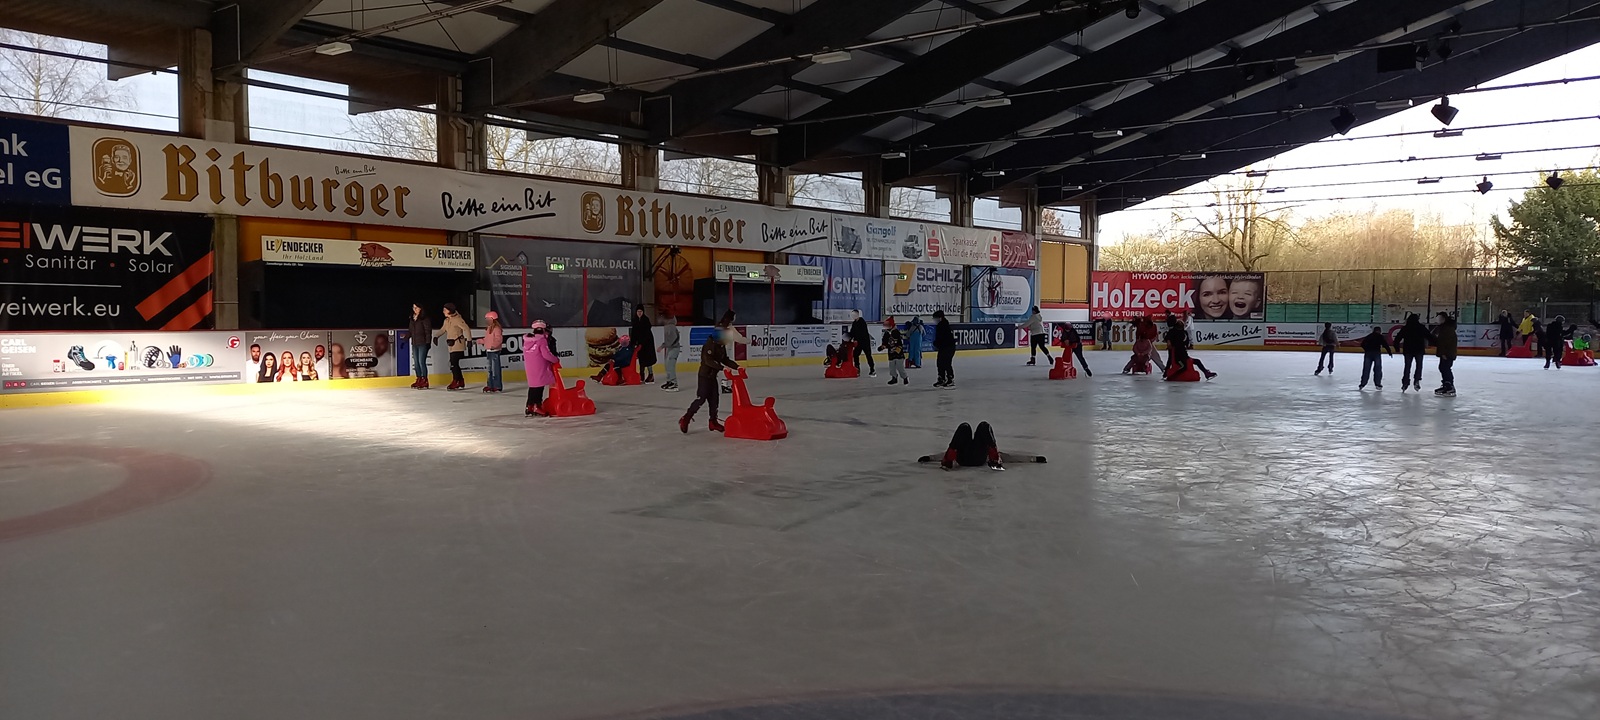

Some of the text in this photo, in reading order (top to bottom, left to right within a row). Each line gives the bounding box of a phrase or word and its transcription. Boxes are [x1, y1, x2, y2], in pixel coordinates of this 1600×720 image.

[25, 168, 62, 189] eG
[160, 142, 411, 219] Bitburger
[441, 187, 556, 219] Bitte ein Bit
[615, 194, 747, 244] Bitburger
[761, 217, 828, 243] Bitte ein Bit
[866, 222, 897, 238] Gangolf
[952, 237, 978, 247] Sparkasse
[25, 254, 174, 273] Sanitär Solar
[575, 258, 608, 269] STARK.
[609, 259, 637, 270] DACH.
[916, 267, 962, 282] SCHILZ
[916, 283, 962, 294] tortechnik
[1092, 282, 1195, 309] Holzeck
[0, 296, 120, 317] eiwerk.eu
[998, 296, 1022, 305] OSBACHER
[1121, 309, 1145, 317] TÜREN
[1, 338, 27, 346] CARL
[253, 331, 319, 343] your Hair your Choice
[751, 333, 788, 350] Raphael
[1196, 325, 1262, 343] Bitte ein Bit
[1, 346, 37, 354] GEISEN
